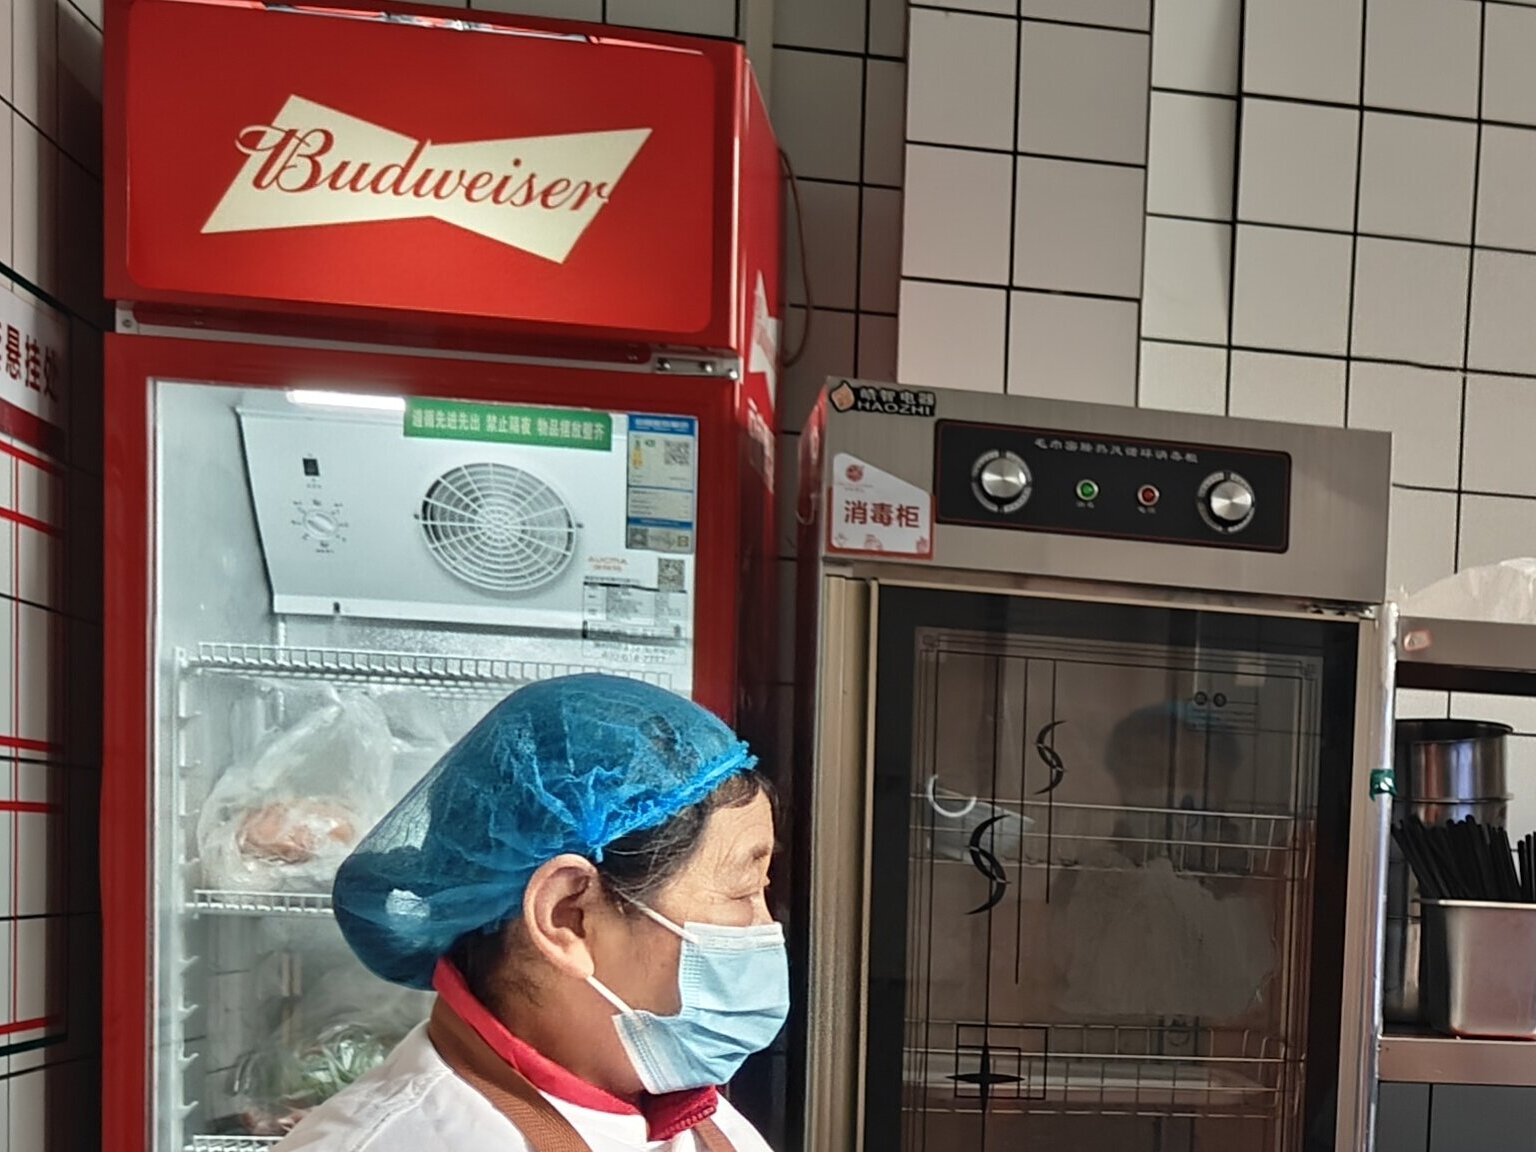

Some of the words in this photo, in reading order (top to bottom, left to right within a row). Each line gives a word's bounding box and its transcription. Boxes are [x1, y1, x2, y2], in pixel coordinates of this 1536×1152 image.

[235, 124, 609, 212] Budweiser
[0, 322, 58, 403] 悬挂处
[857, 401, 931, 416] HAOZHI
[844, 500, 920, 528] 消毒柜
